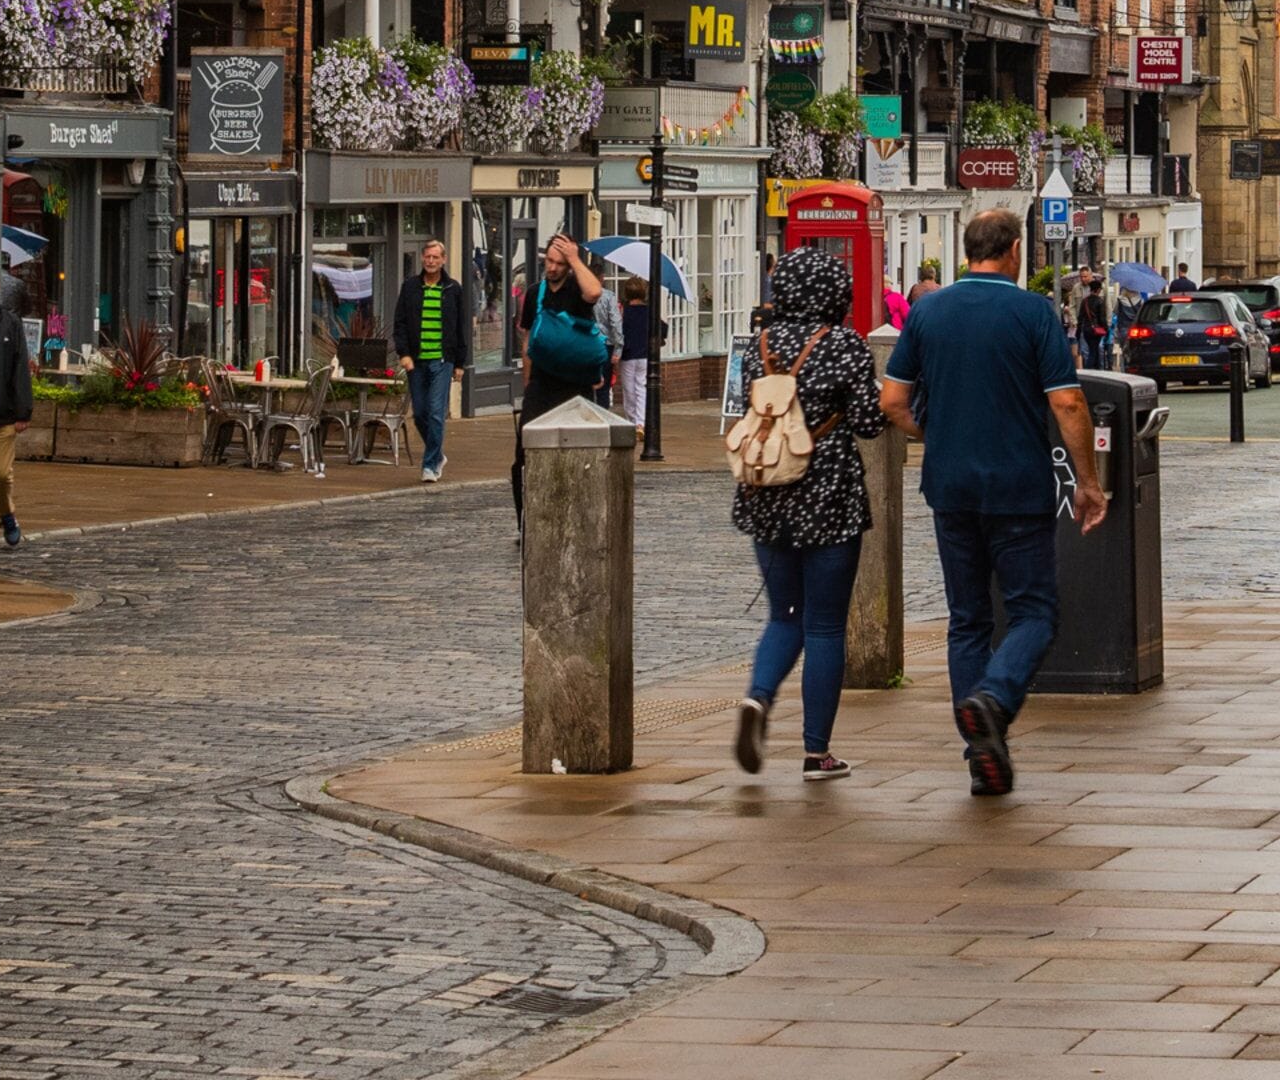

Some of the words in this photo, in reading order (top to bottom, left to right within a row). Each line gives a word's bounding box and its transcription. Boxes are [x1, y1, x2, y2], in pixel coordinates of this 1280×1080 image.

[689, 5, 741, 47] MR.
[1141, 41, 1179, 49] CHESTER
[475, 49, 508, 57] DEVA
[1145, 49, 1175, 57] MODEL
[212, 56, 262, 73] Burger
[215, 109, 257, 119] BURGERS
[623, 105, 652, 115] GATE
[224, 119, 248, 129] BEER
[49, 122, 87, 148] Burger
[217, 130, 255, 139] SHAKES
[962, 161, 1015, 176] COFFEE
[365, 168, 388, 194] LILY
[392, 168, 439, 194] VINTAGE
[799, 210, 858, 219] TELEPHONE
[1049, 201, 1064, 220] P
